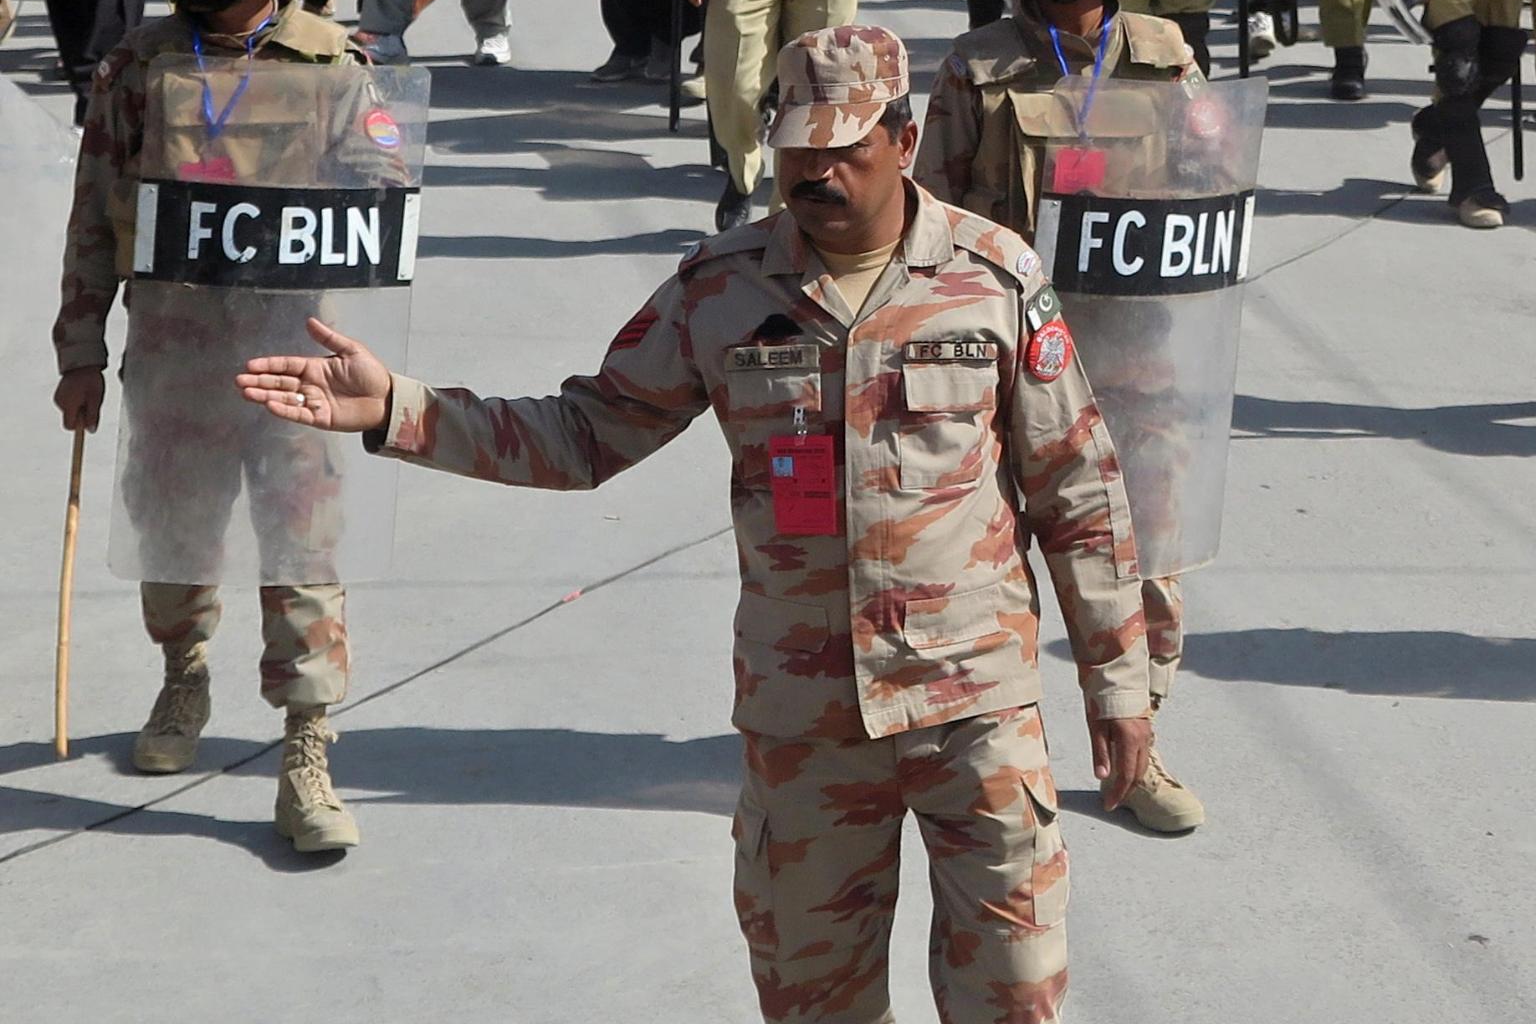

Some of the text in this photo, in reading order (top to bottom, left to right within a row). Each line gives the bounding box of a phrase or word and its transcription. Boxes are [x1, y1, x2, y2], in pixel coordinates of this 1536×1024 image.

[187, 202, 381, 267] FC BLN
[1078, 208, 1236, 278] FC BLN
[734, 350, 804, 368] SALEEM
[919, 343, 987, 358] FC BLN
